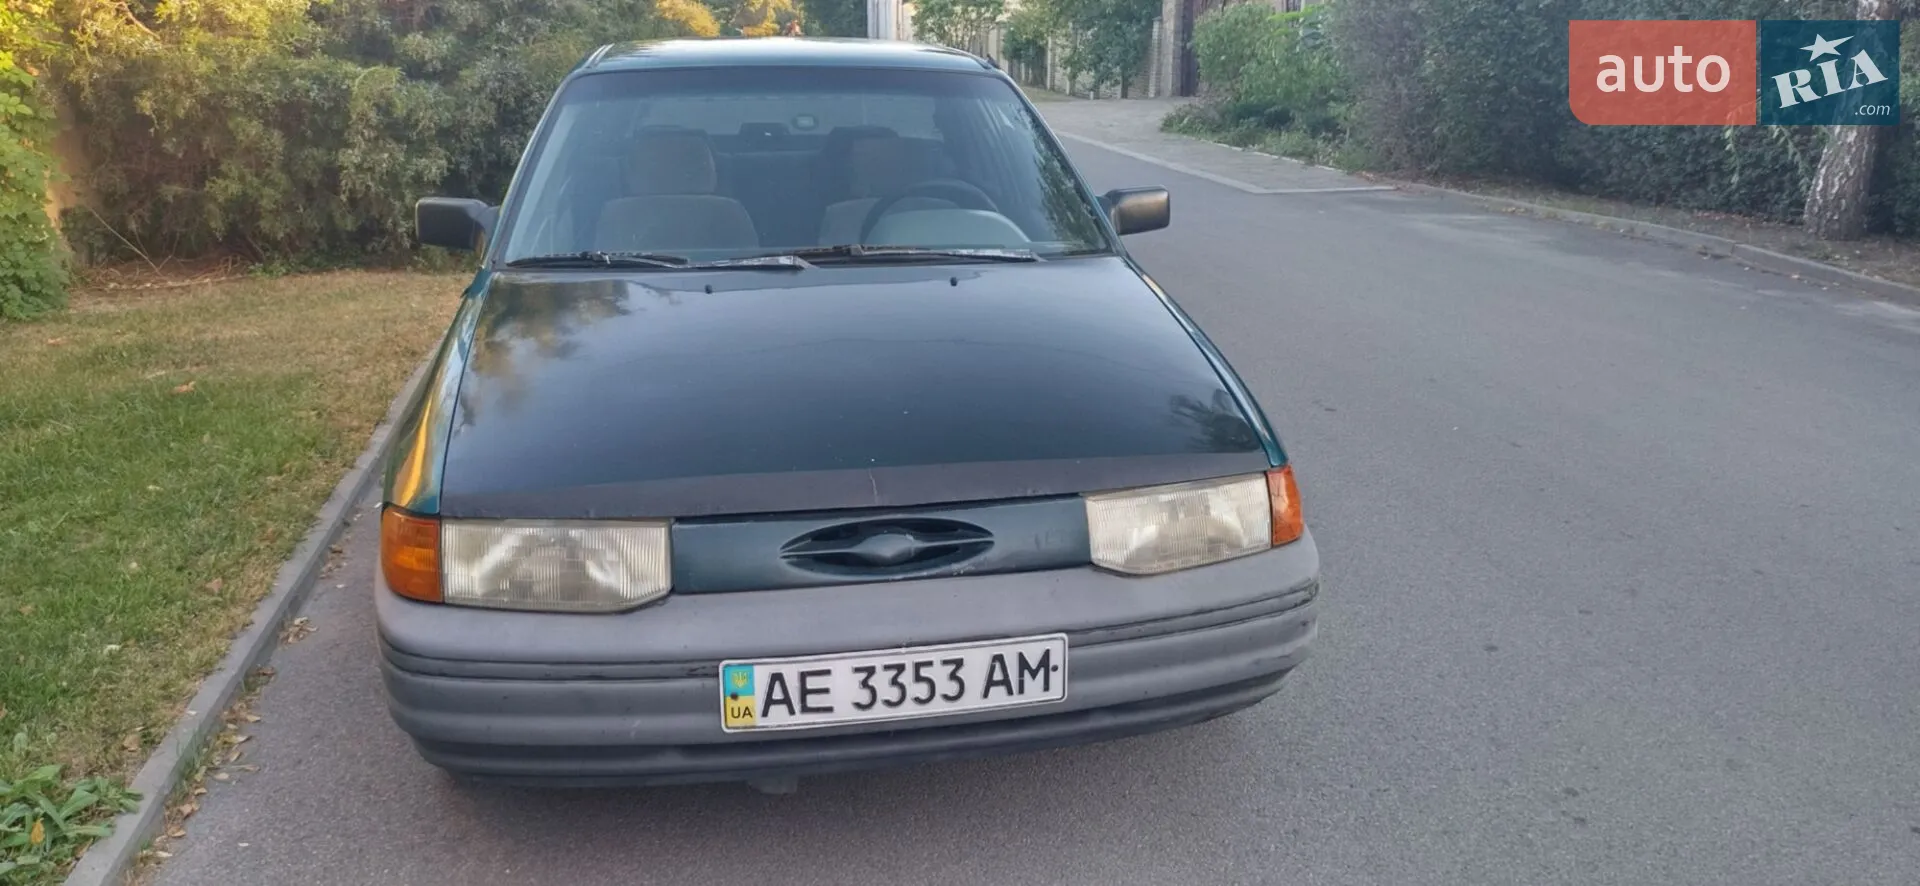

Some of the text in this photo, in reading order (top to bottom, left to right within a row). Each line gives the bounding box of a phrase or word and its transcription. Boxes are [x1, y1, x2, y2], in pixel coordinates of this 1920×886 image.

[761, 648, 1052, 718] AE 3353 AM
[731, 706, 754, 720] UA
